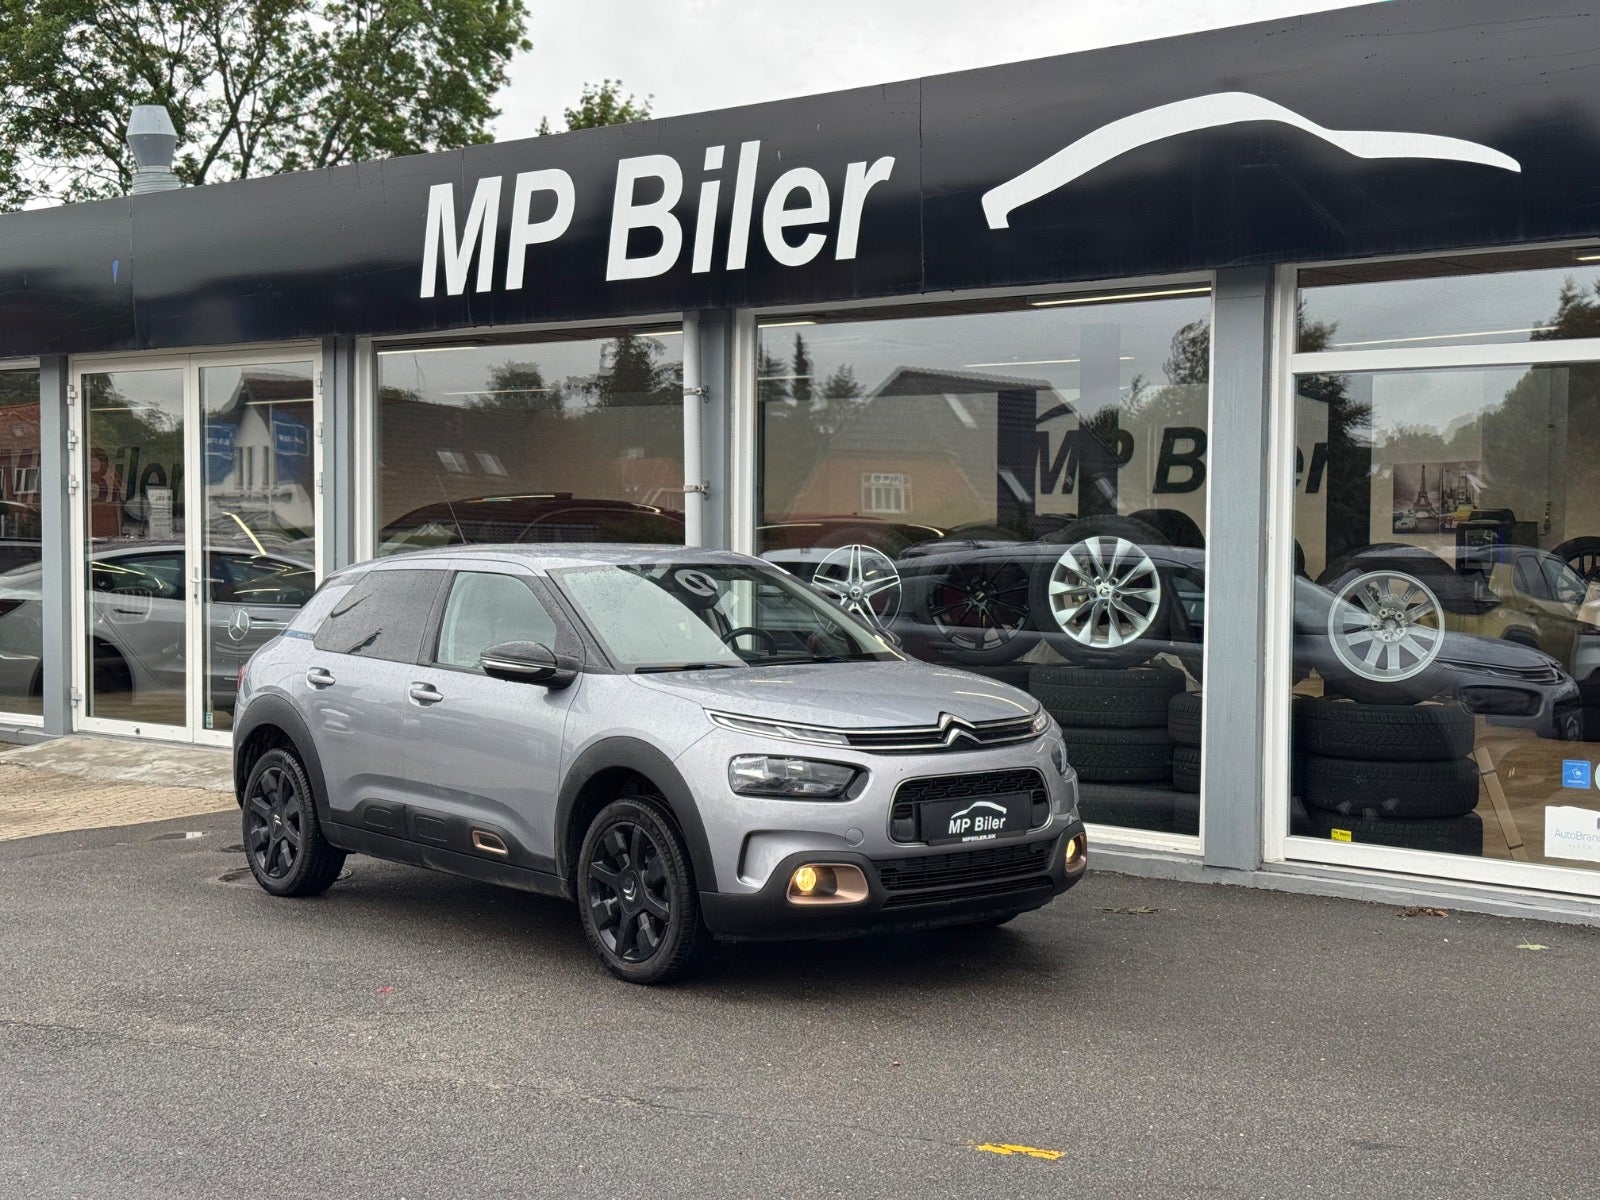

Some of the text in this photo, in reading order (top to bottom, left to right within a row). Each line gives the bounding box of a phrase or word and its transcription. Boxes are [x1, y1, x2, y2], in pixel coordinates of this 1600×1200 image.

[420, 140, 896, 299] MP Biler
[948, 815, 1006, 834] MP Biler
